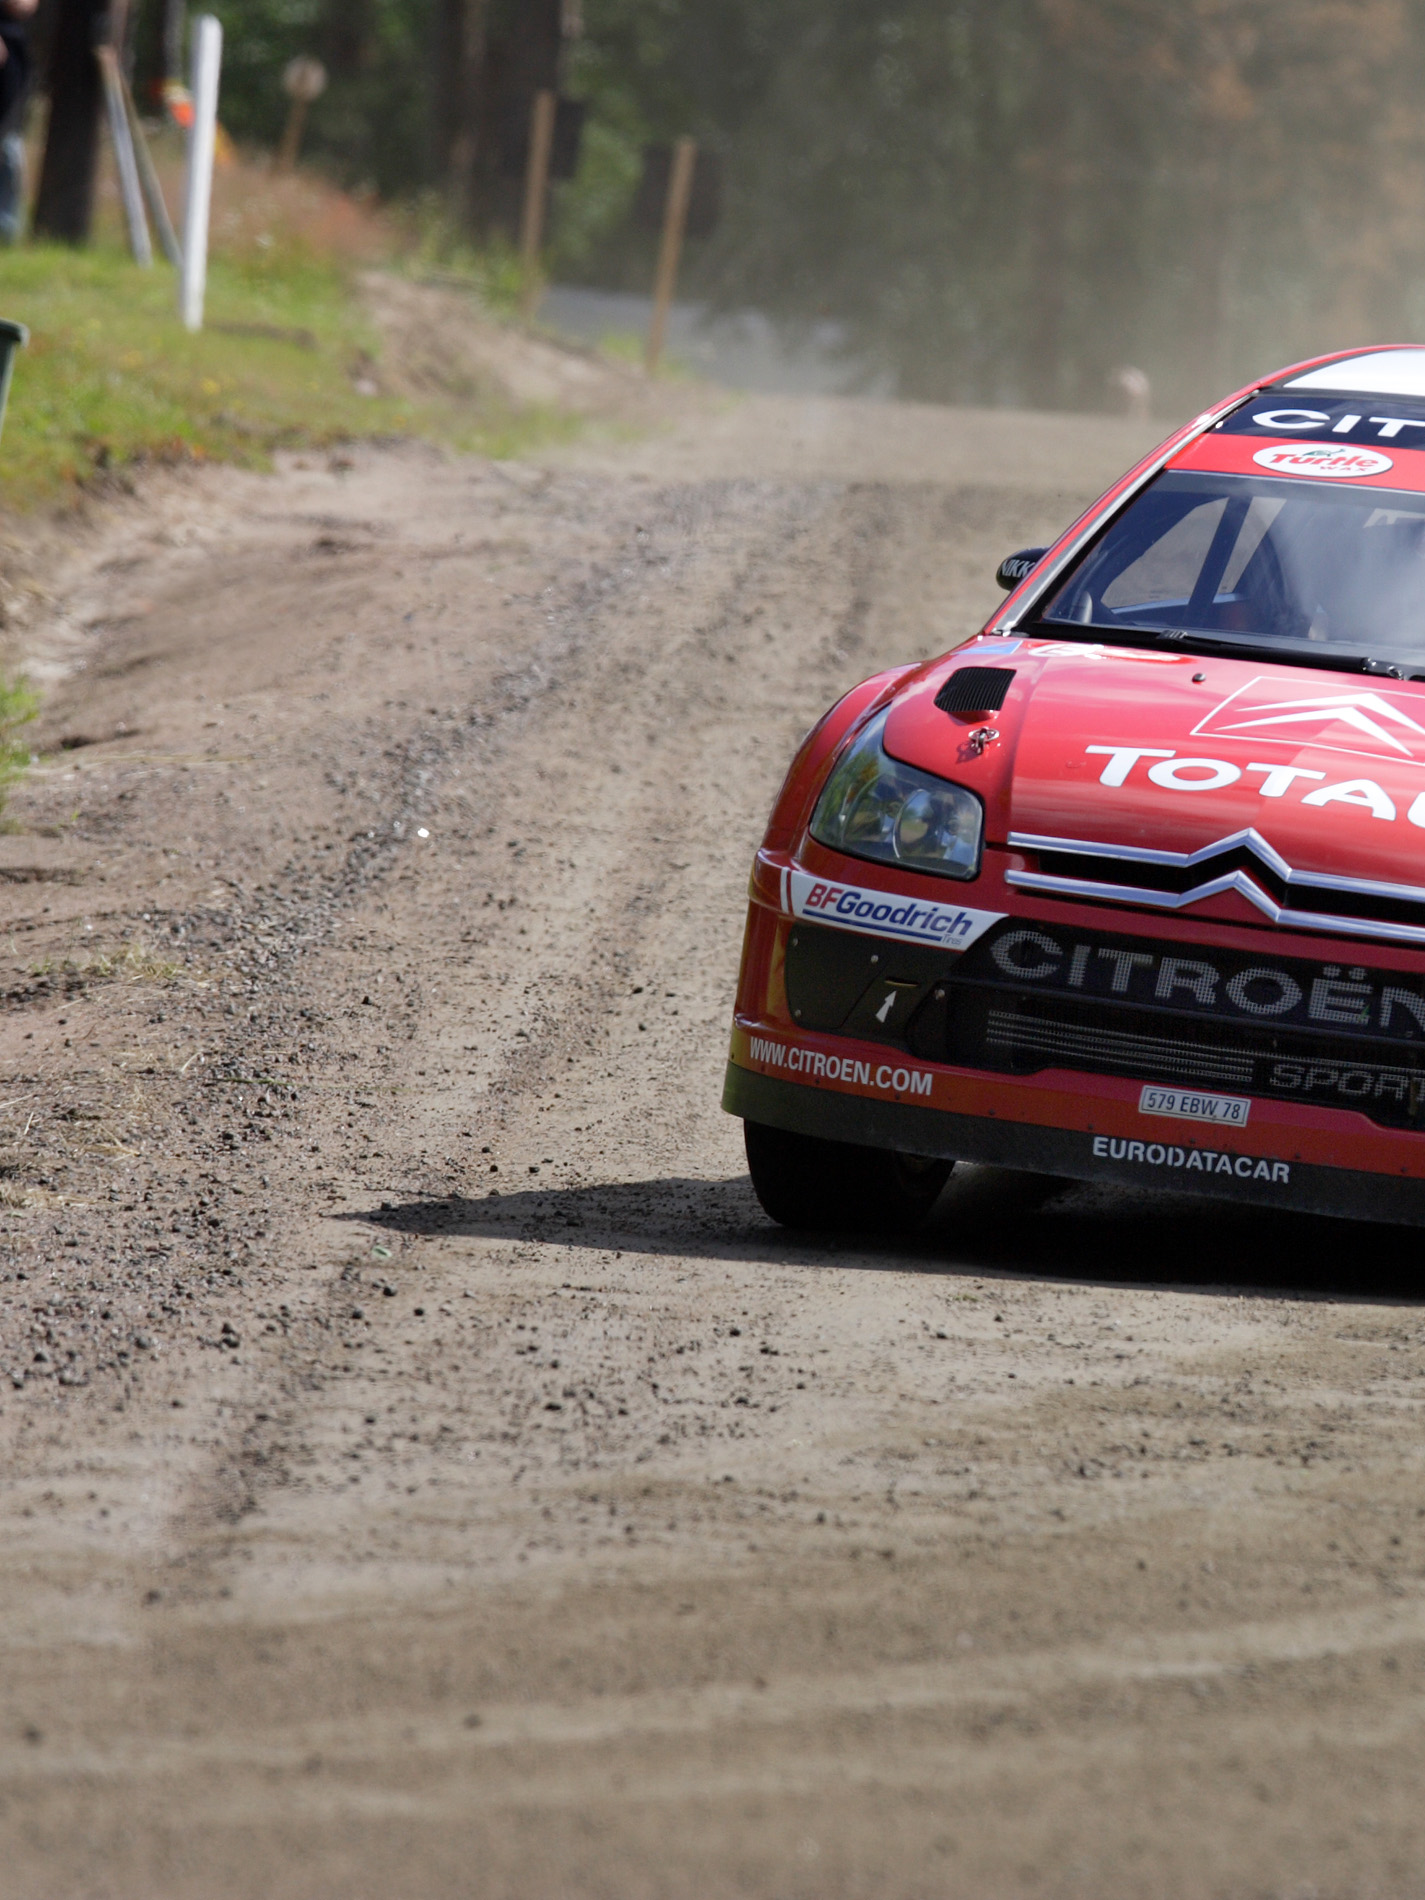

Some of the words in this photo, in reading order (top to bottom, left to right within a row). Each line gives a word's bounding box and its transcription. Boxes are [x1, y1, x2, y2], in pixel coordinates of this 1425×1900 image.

[1269, 453, 1379, 468] Turtle
[1001, 559, 1036, 578] NIKK
[805, 882, 973, 937] BFGoodrich
[750, 1037, 933, 1096] WWW.CITROEN.COM
[1147, 1092, 1176, 1111] 579
[1180, 1096, 1219, 1116] EBW
[1223, 1102, 1241, 1120] 78
[1092, 1136, 1290, 1184] EURODATACAR
